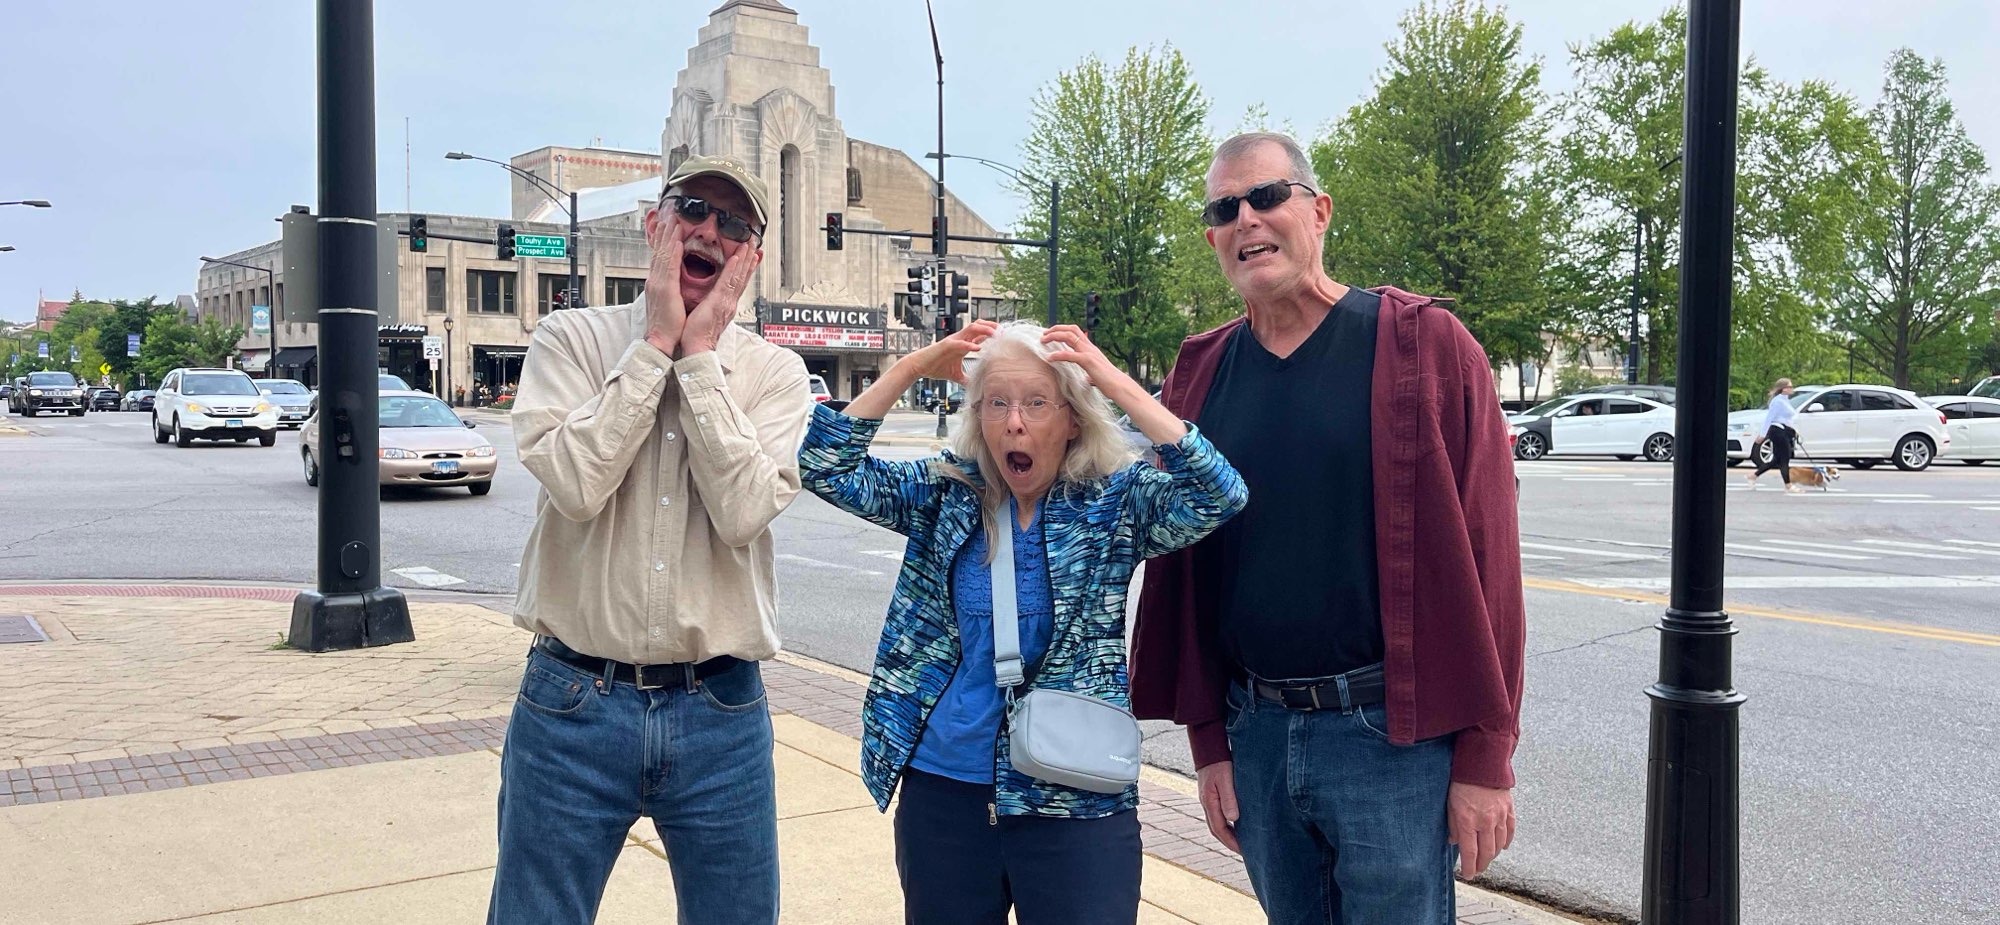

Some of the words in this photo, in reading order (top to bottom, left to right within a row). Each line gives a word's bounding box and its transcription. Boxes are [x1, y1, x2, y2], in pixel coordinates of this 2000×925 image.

[521, 236, 542, 245] Touhy
[546, 238, 561, 246] Ave
[518, 246, 546, 255] Prospect
[782, 308, 870, 325] PICKWICK
[426, 347, 441, 356] 25
